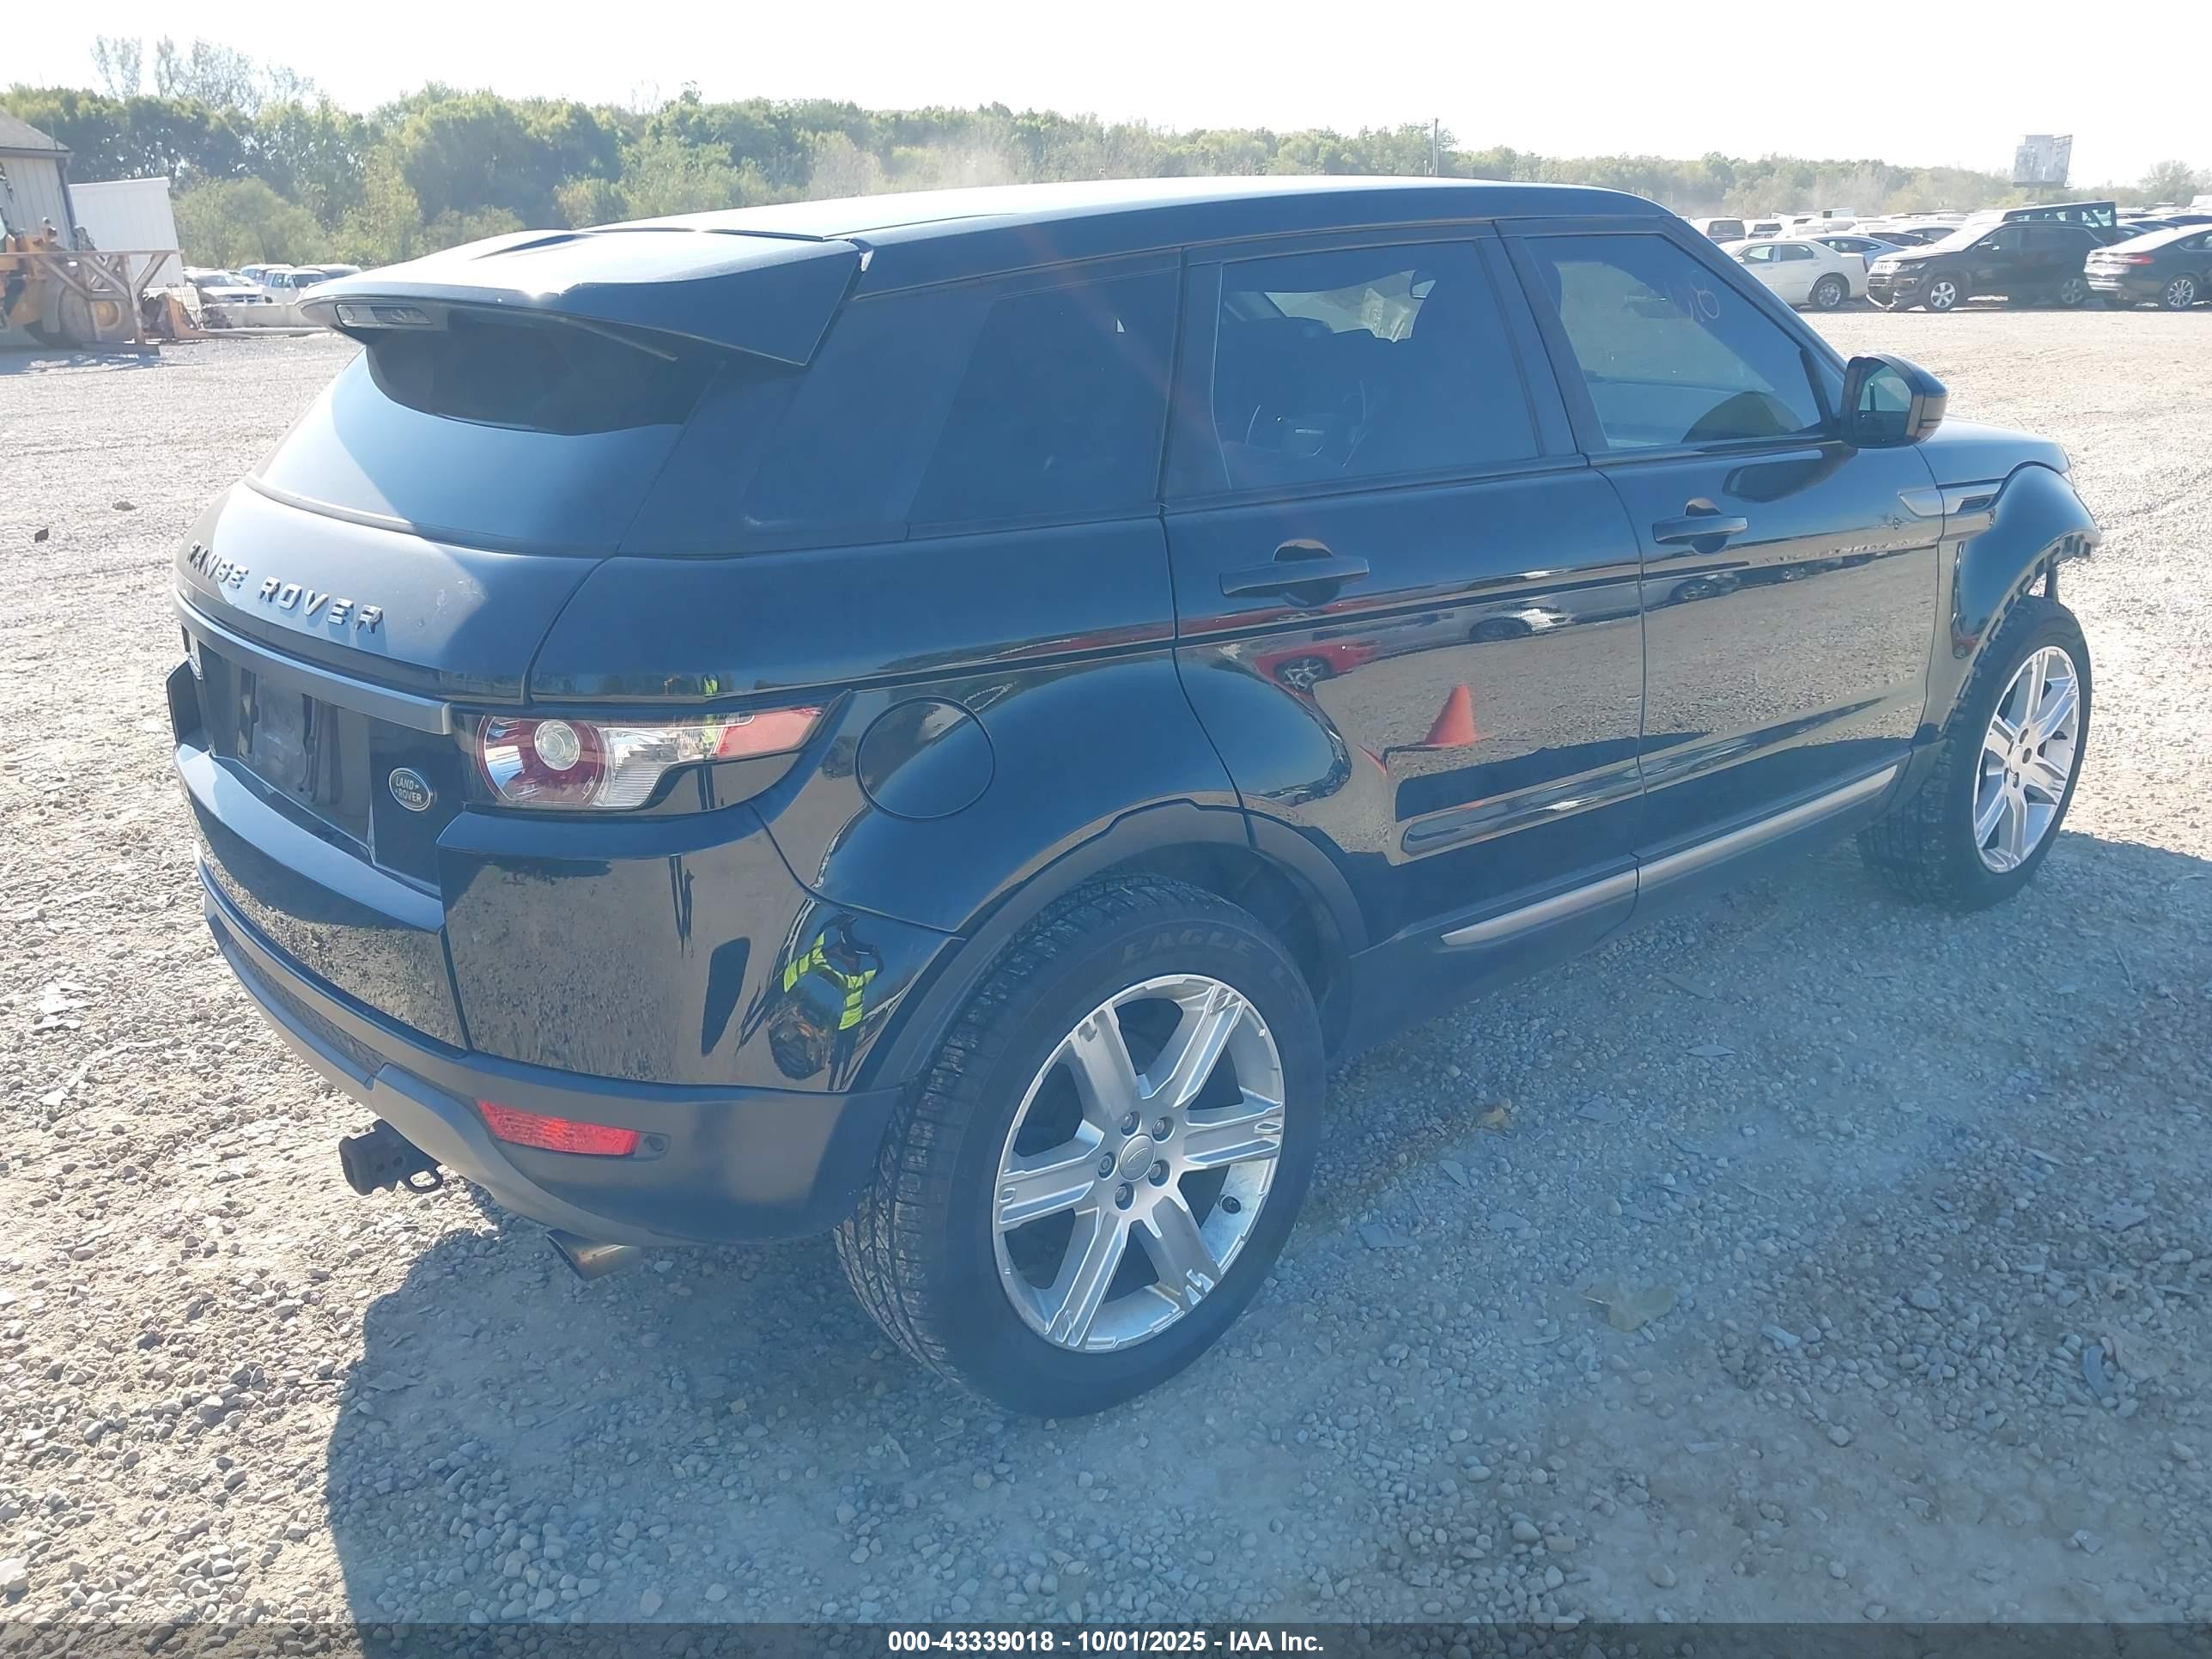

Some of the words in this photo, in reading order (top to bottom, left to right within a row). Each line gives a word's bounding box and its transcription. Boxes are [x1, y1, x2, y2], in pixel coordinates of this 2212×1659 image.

[258, 576, 383, 634] ROVER
[396, 776, 414, 790] LAND
[398, 788, 422, 804] ROVER
[1121, 927, 1255, 963] EAGLE
